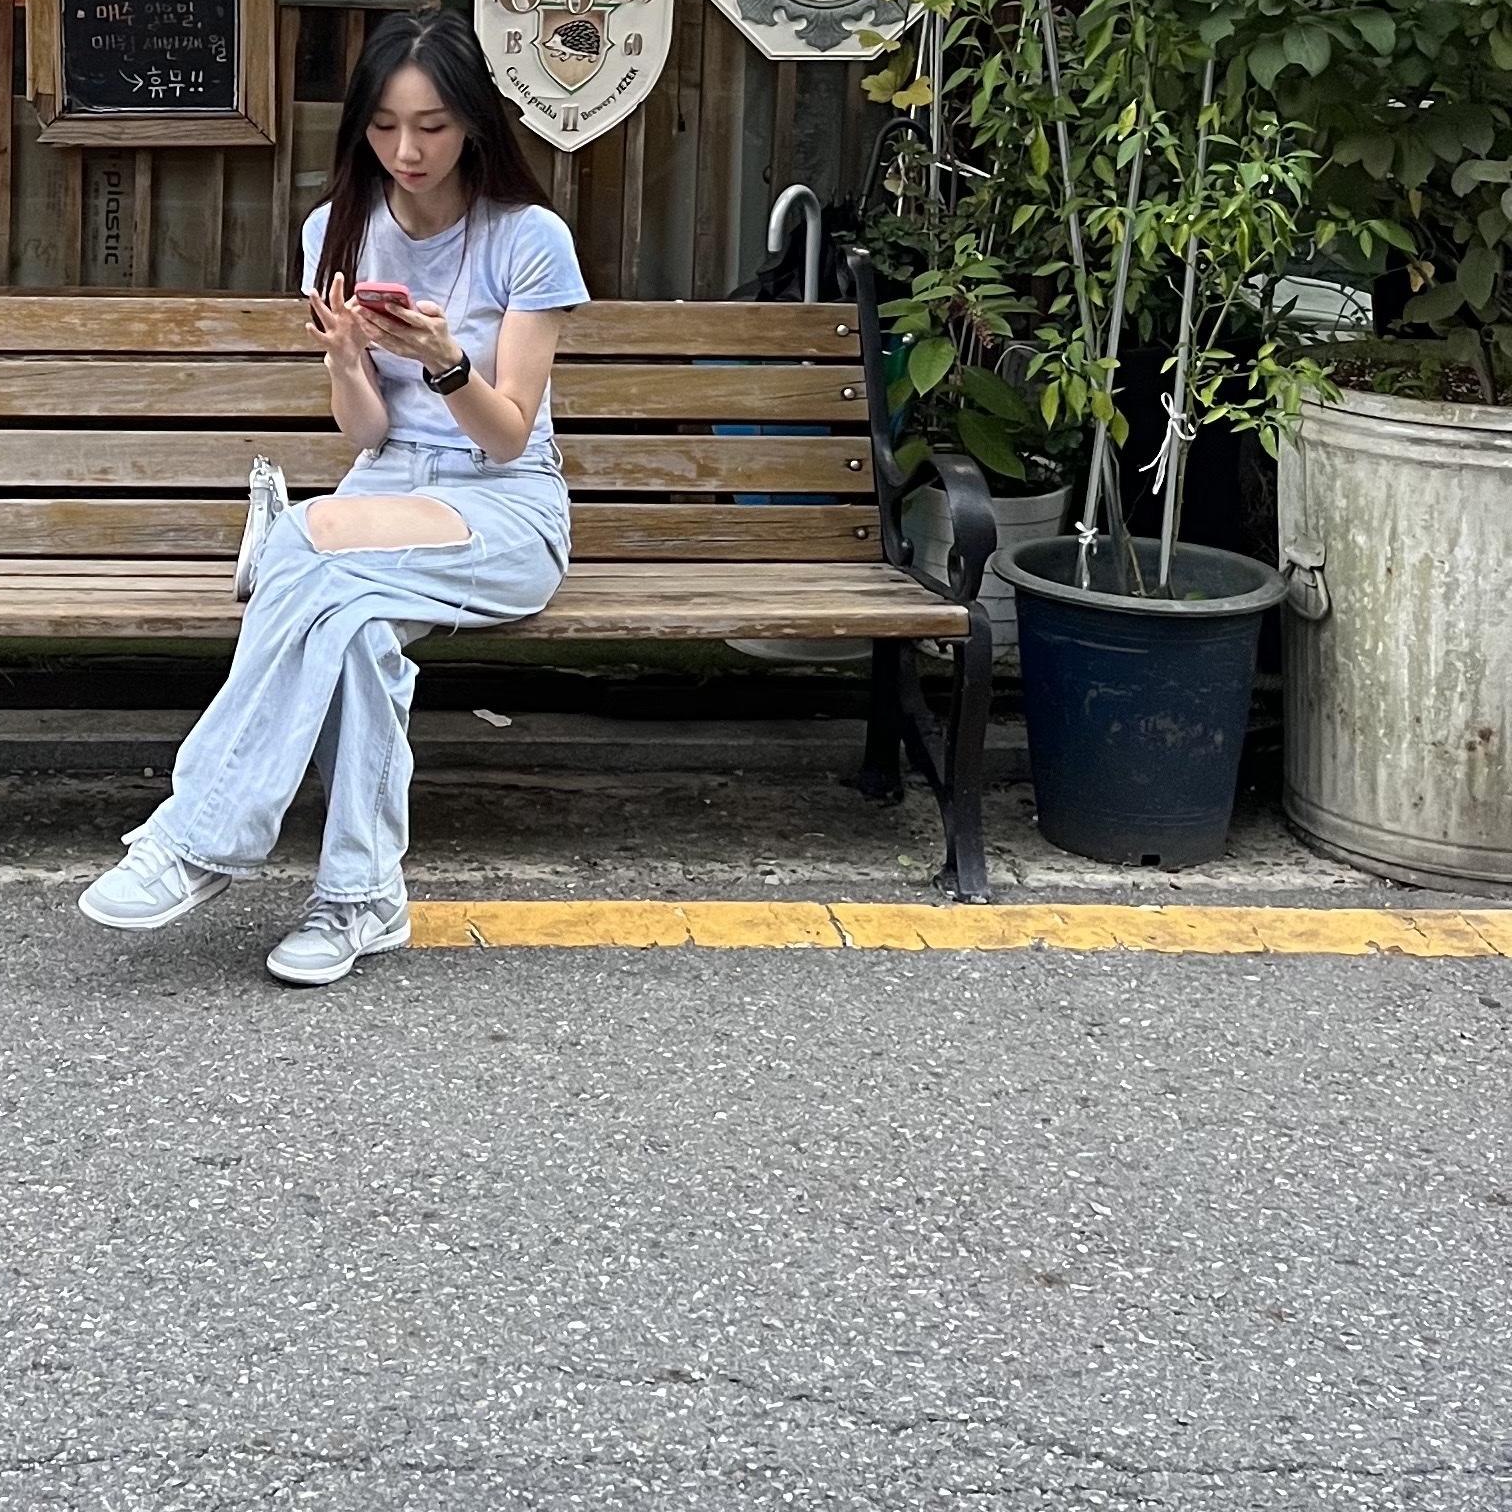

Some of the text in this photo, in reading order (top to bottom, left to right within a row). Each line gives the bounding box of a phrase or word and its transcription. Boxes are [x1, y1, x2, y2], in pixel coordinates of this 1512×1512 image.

[506, 66, 558, 120] Castle praha
[580, 95, 617, 121] Brewery
